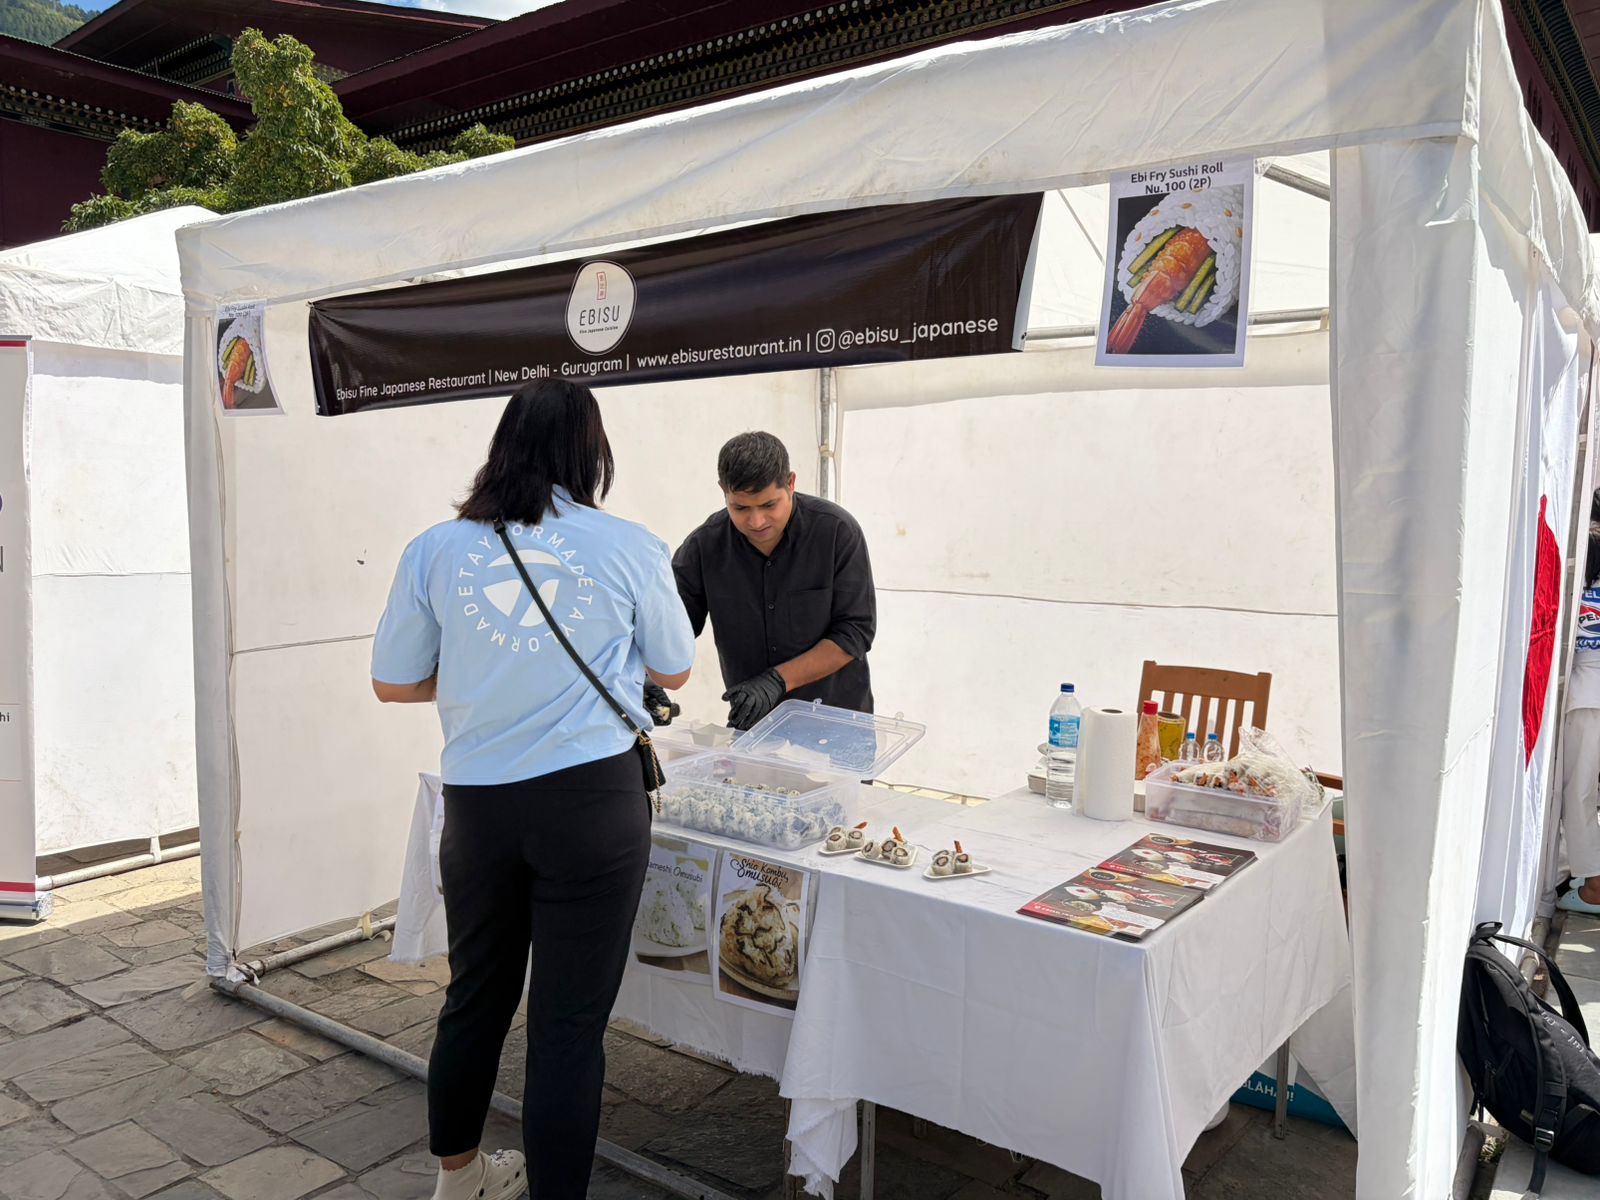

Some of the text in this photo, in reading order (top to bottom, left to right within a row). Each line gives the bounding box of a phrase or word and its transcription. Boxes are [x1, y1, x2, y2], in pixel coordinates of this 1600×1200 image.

[1131, 161, 1223, 183] Ebi Fry Sushi Roll
[1145, 176, 1211, 194] Nu. 100 (2P)
[579, 305, 620, 326] EBISU
[336, 388, 358, 400] Ebisu
[360, 385, 378, 397] Fine
[380, 381, 426, 397] Japanese
[428, 370, 486, 389] Restaurant
[494, 370, 519, 382] New
[521, 364, 550, 379] Delhi
[561, 359, 623, 376] Gurugram
[637, 337, 802, 368] www.ebisurestaurant.in
[838, 318, 999, 350] @ebisu_japanese
